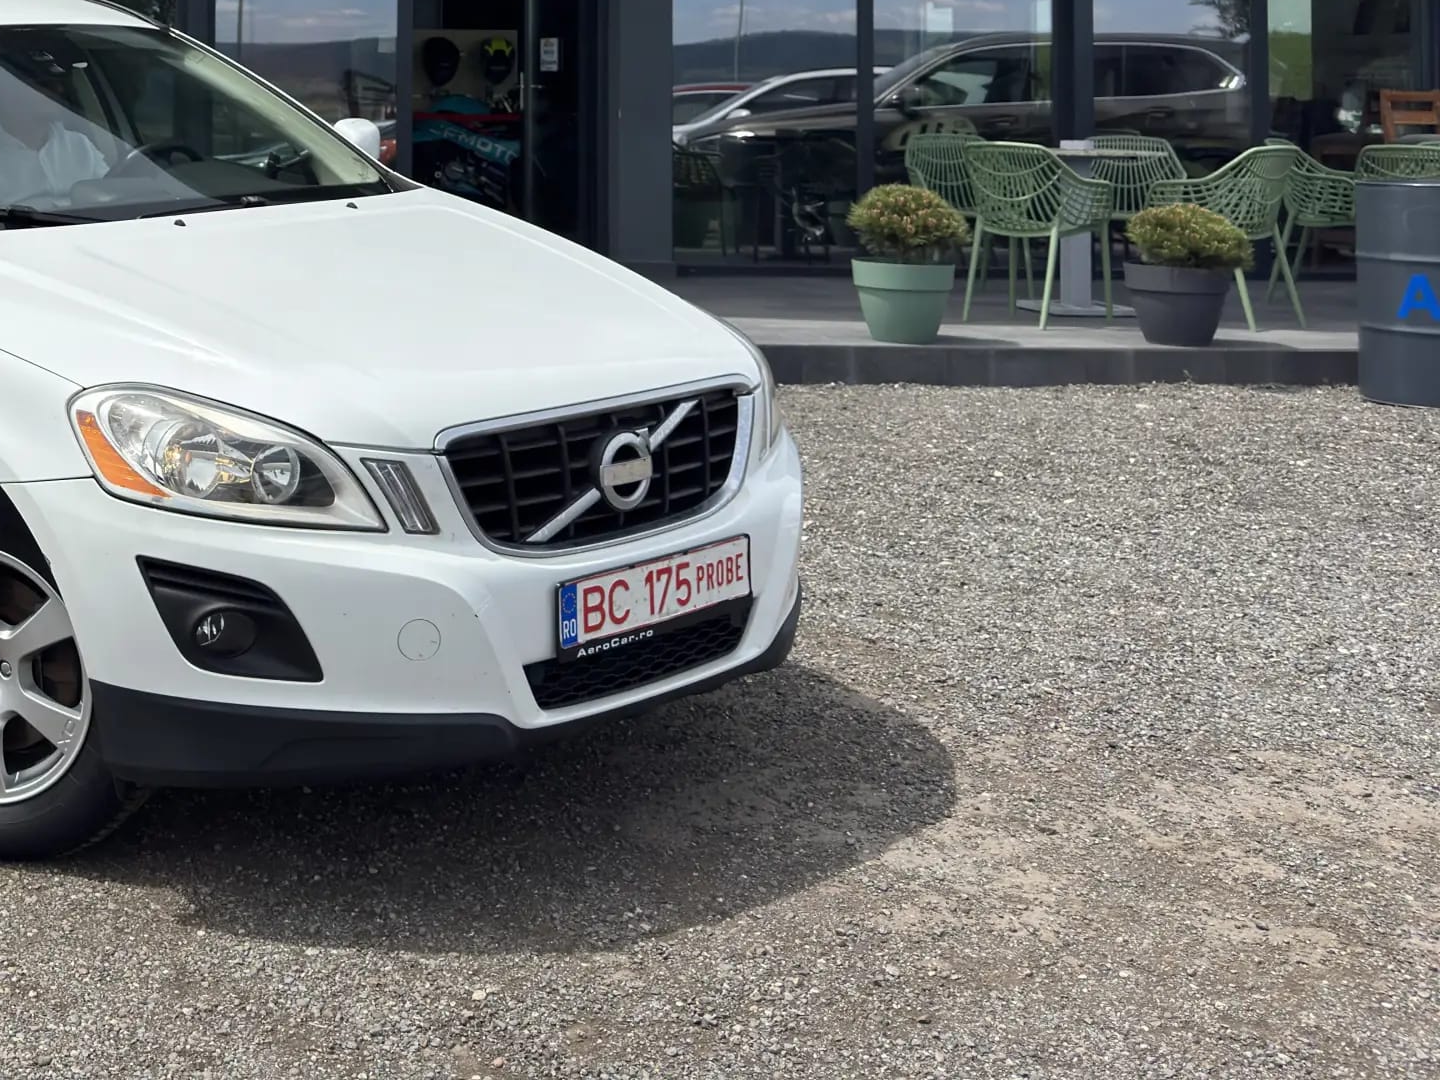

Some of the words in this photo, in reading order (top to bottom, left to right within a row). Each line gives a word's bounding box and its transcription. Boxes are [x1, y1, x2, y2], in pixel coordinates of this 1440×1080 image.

[582, 579, 631, 634] BC
[644, 561, 692, 616] 175
[695, 552, 744, 595] PROBE
[562, 619, 577, 640] RO
[576, 628, 655, 659] AeroCar.ro
